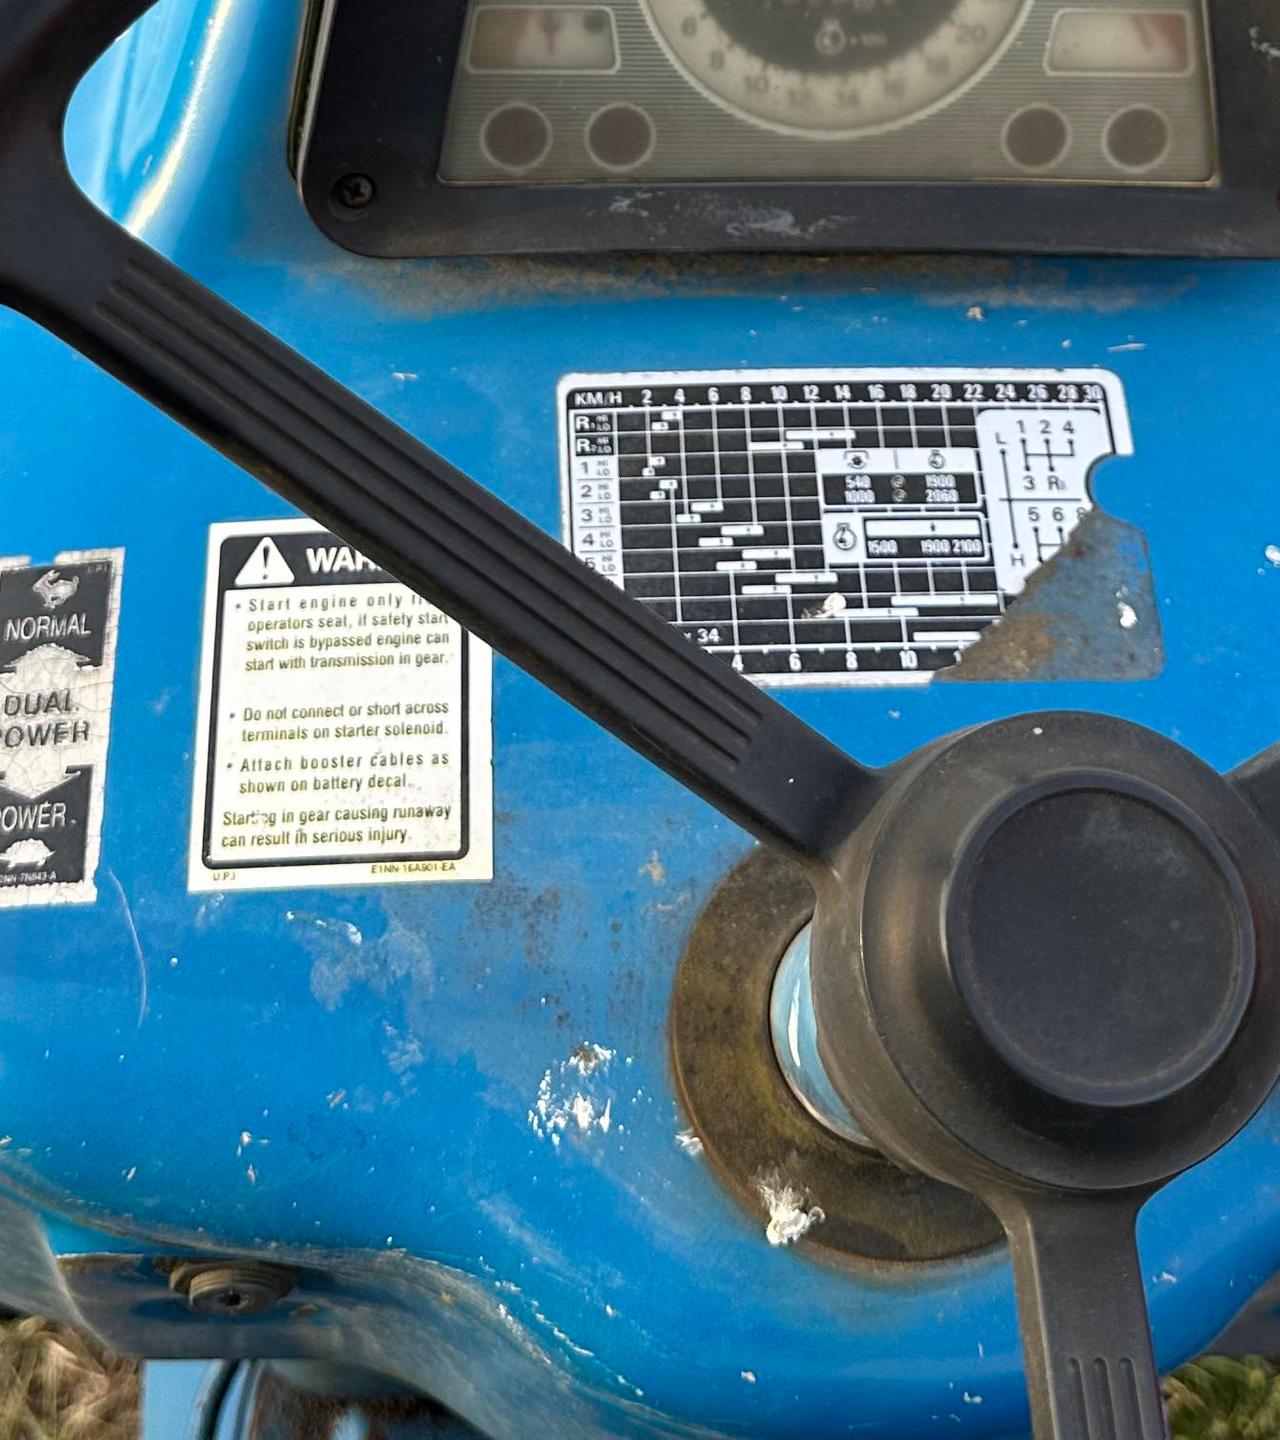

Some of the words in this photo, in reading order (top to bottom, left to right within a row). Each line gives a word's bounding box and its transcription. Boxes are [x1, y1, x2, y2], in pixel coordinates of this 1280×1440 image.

[574, 391, 622, 407] KM/H
[641, 389, 652, 403] 2
[674, 388, 686, 403] 4
[707, 387, 719, 402] 6
[740, 386, 752, 402] 8
[770, 385, 788, 401] 10
[803, 385, 820, 400] 12
[834, 385, 852, 400] 14
[867, 384, 885, 400] 16
[899, 384, 917, 400] 18
[930, 384, 952, 400] 20
[963, 384, 984, 400] 22
[994, 384, 1017, 400] 24
[1026, 384, 1049, 400] 26
[1057, 384, 1079, 400] 28
[1083, 384, 1104, 400] 30
[1016, 420, 1024, 434] 1
[1040, 420, 1052, 434] 2
[1063, 420, 1074, 434] 4
[995, 432, 1007, 445] L
[580, 461, 588, 474] 1
[581, 484, 592, 498] 2
[1023, 475, 1035, 490] 3
[581, 508, 593, 522] 3
[1028, 507, 1039, 522] 5
[1052, 507, 1064, 522] 6
[582, 533, 595, 546] 4
[1010, 554, 1025, 567] H
[249, 597, 290, 612] Start
[299, 596, 358, 613] engine
[366, 593, 403, 610] only
[4, 613, 91, 642] NORMAL
[248, 615, 313, 634] operators
[318, 615, 352, 630] seat,
[358, 614, 368, 627] if
[371, 612, 413, 630] safety
[417, 611, 449, 626] start
[246, 637, 289, 652] switch
[293, 636, 305, 649] is
[309, 633, 371, 652] bypassed
[377, 632, 422, 649] engine
[426, 632, 450, 646] can
[697, 628, 720, 644] 34
[245, 658, 275, 672] start
[279, 656, 306, 670] with
[310, 654, 395, 669] transmission
[399, 653, 412, 665] in
[415, 652, 449, 667] gear.
[732, 653, 744, 671] 4
[789, 652, 801, 671] 6
[847, 652, 858, 670] 8
[900, 650, 918, 669] 10
[4, 688, 75, 716] DUAL
[243, 707, 262, 722] Do
[266, 707, 288, 720] not
[291, 705, 345, 720] connect
[348, 705, 362, 717] or
[366, 702, 401, 717] short
[405, 701, 449, 715] across
[241, 727, 308, 742] terminals
[313, 726, 330, 739] on
[334, 723, 380, 739] starter
[384, 721, 449, 736] solenoid.
[240, 757, 292, 773] Attach
[300, 754, 362, 770] booster
[370, 752, 424, 767] cables
[431, 752, 449, 765] as
[239, 779, 285, 795] shown
[290, 779, 308, 792] on
[313, 775, 363, 792] battery
[282, 809, 295, 824] in
[299, 809, 330, 826] gear
[334, 806, 388, 823] causing
[392, 805, 451, 821] runaway
[221, 835, 246, 848] can
[250, 831, 290, 846] result
[295, 830, 308, 844] in
[312, 828, 363, 844] serious
[368, 827, 412, 844] injury.
